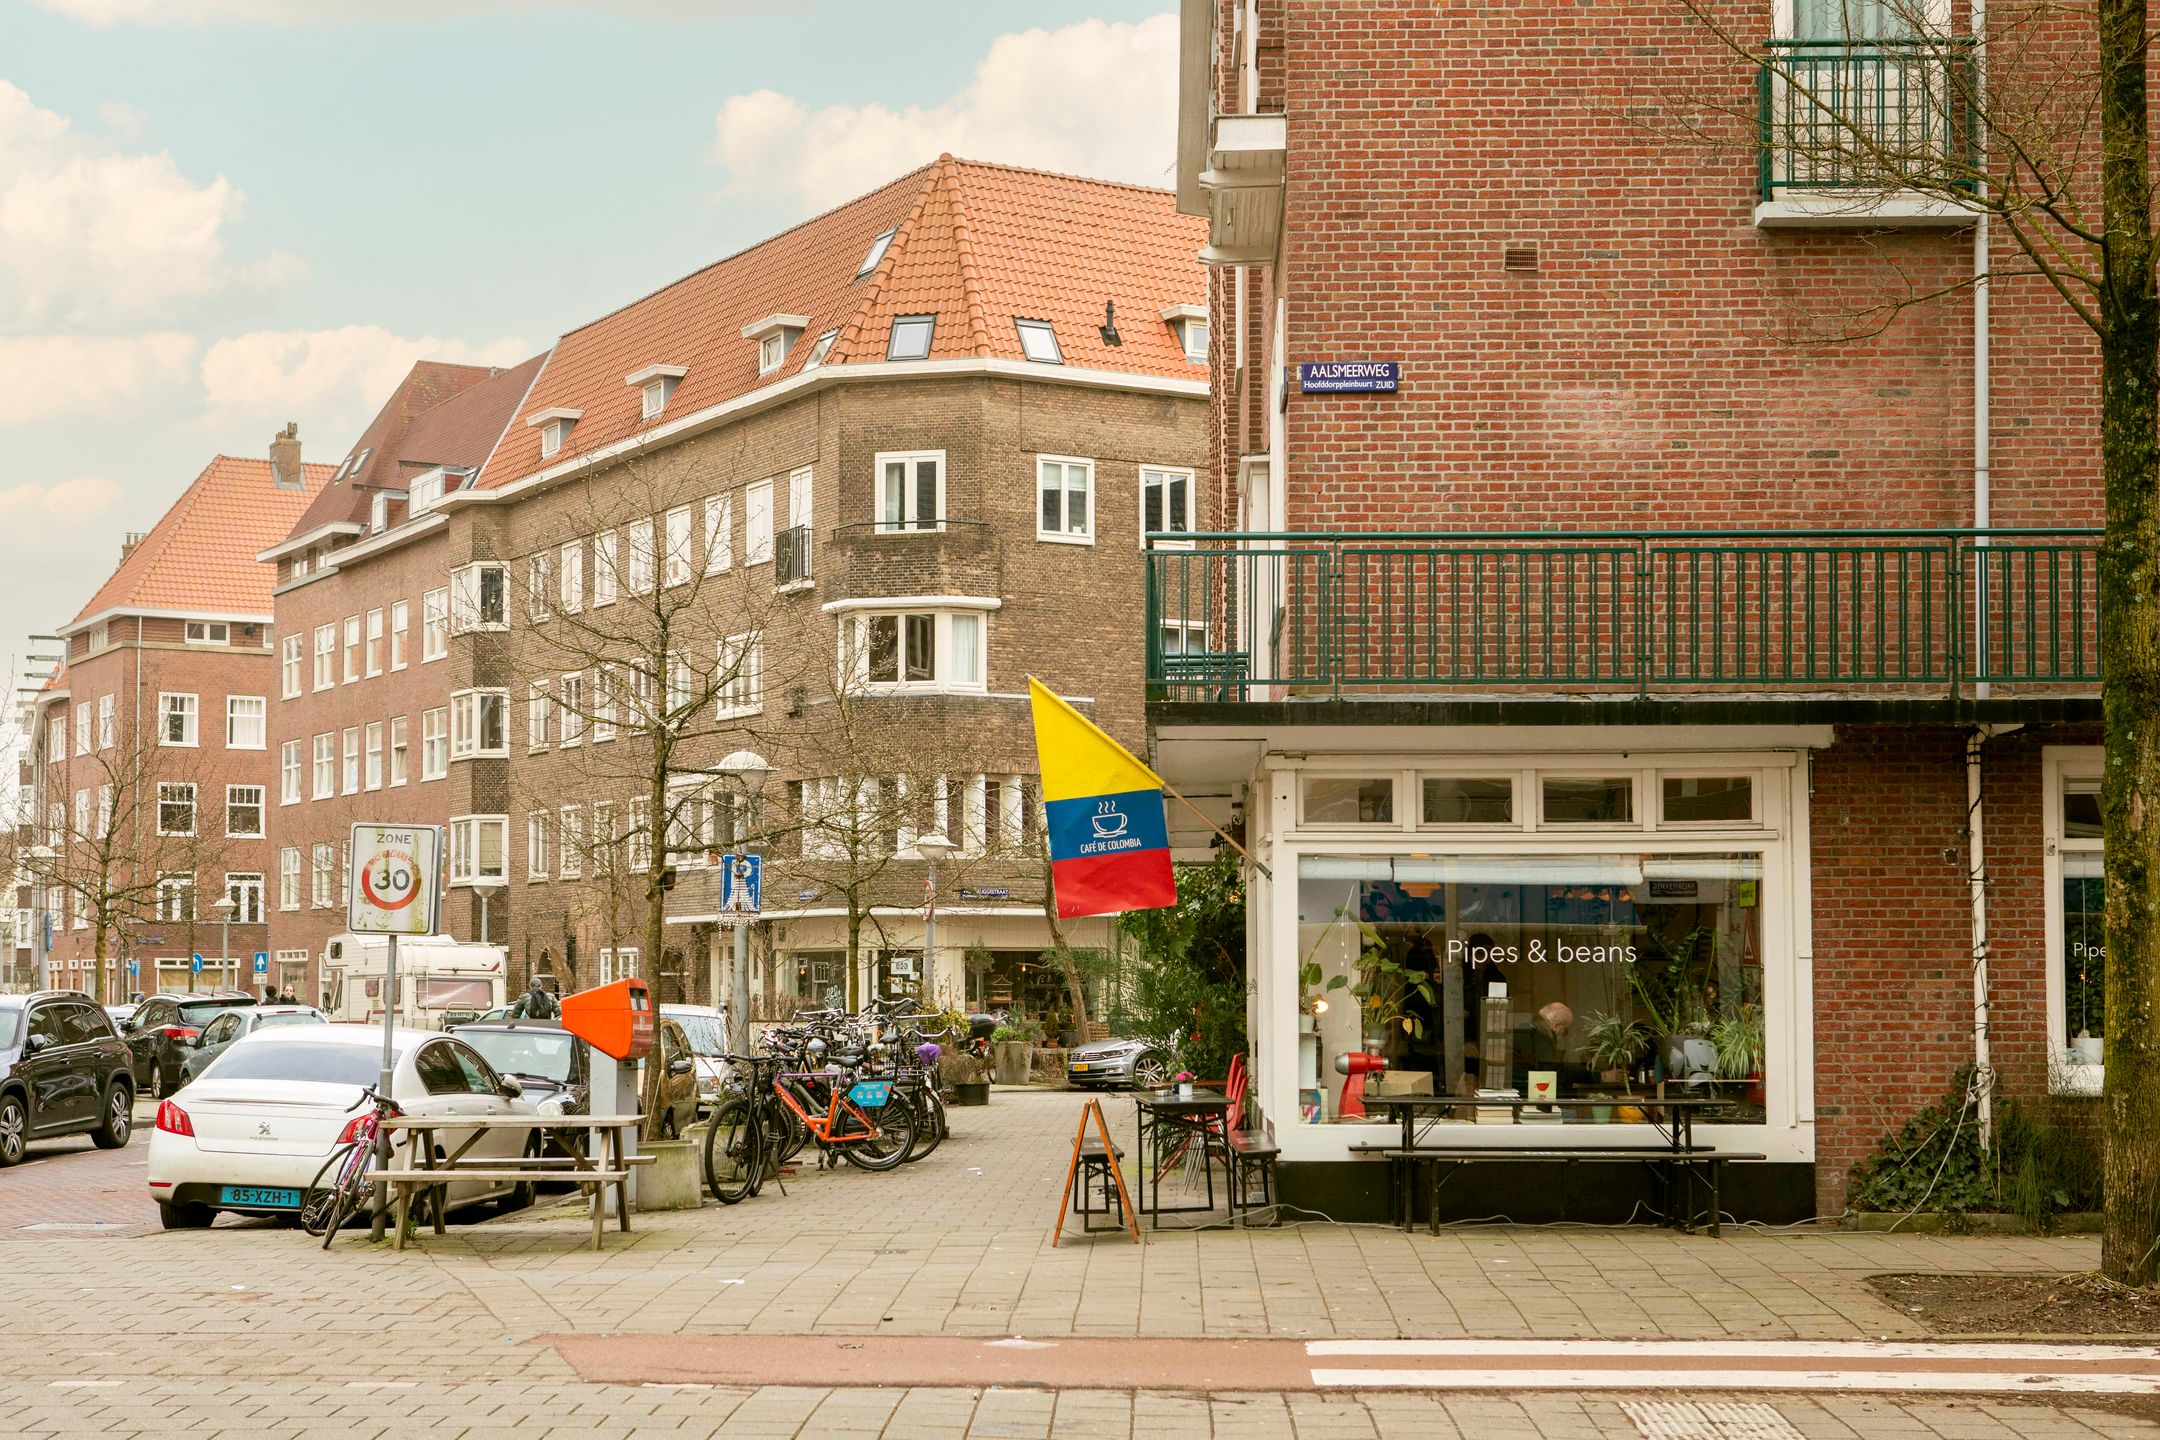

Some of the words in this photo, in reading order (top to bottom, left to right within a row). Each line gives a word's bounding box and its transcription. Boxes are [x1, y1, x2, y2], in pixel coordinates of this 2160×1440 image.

[1310, 364, 1389, 378] AALSMEERWEG
[1304, 380, 1373, 390] Hoofddorppleinbuurt
[1375, 381, 1395, 389] ZUID
[376, 833, 412, 845] ZONE
[1080, 841, 1097, 854] CAFÉ
[1097, 842, 1107, 852] DE
[1107, 837, 1142, 851] COLOMBIA
[374, 868, 411, 891] 30
[1447, 939, 1518, 970] Pipes
[1528, 939, 1547, 963] &
[1557, 938, 1637, 963] beans
[2074, 942, 2106, 961] Pipe
[232, 1189, 292, 1204] 85-XZH-1
